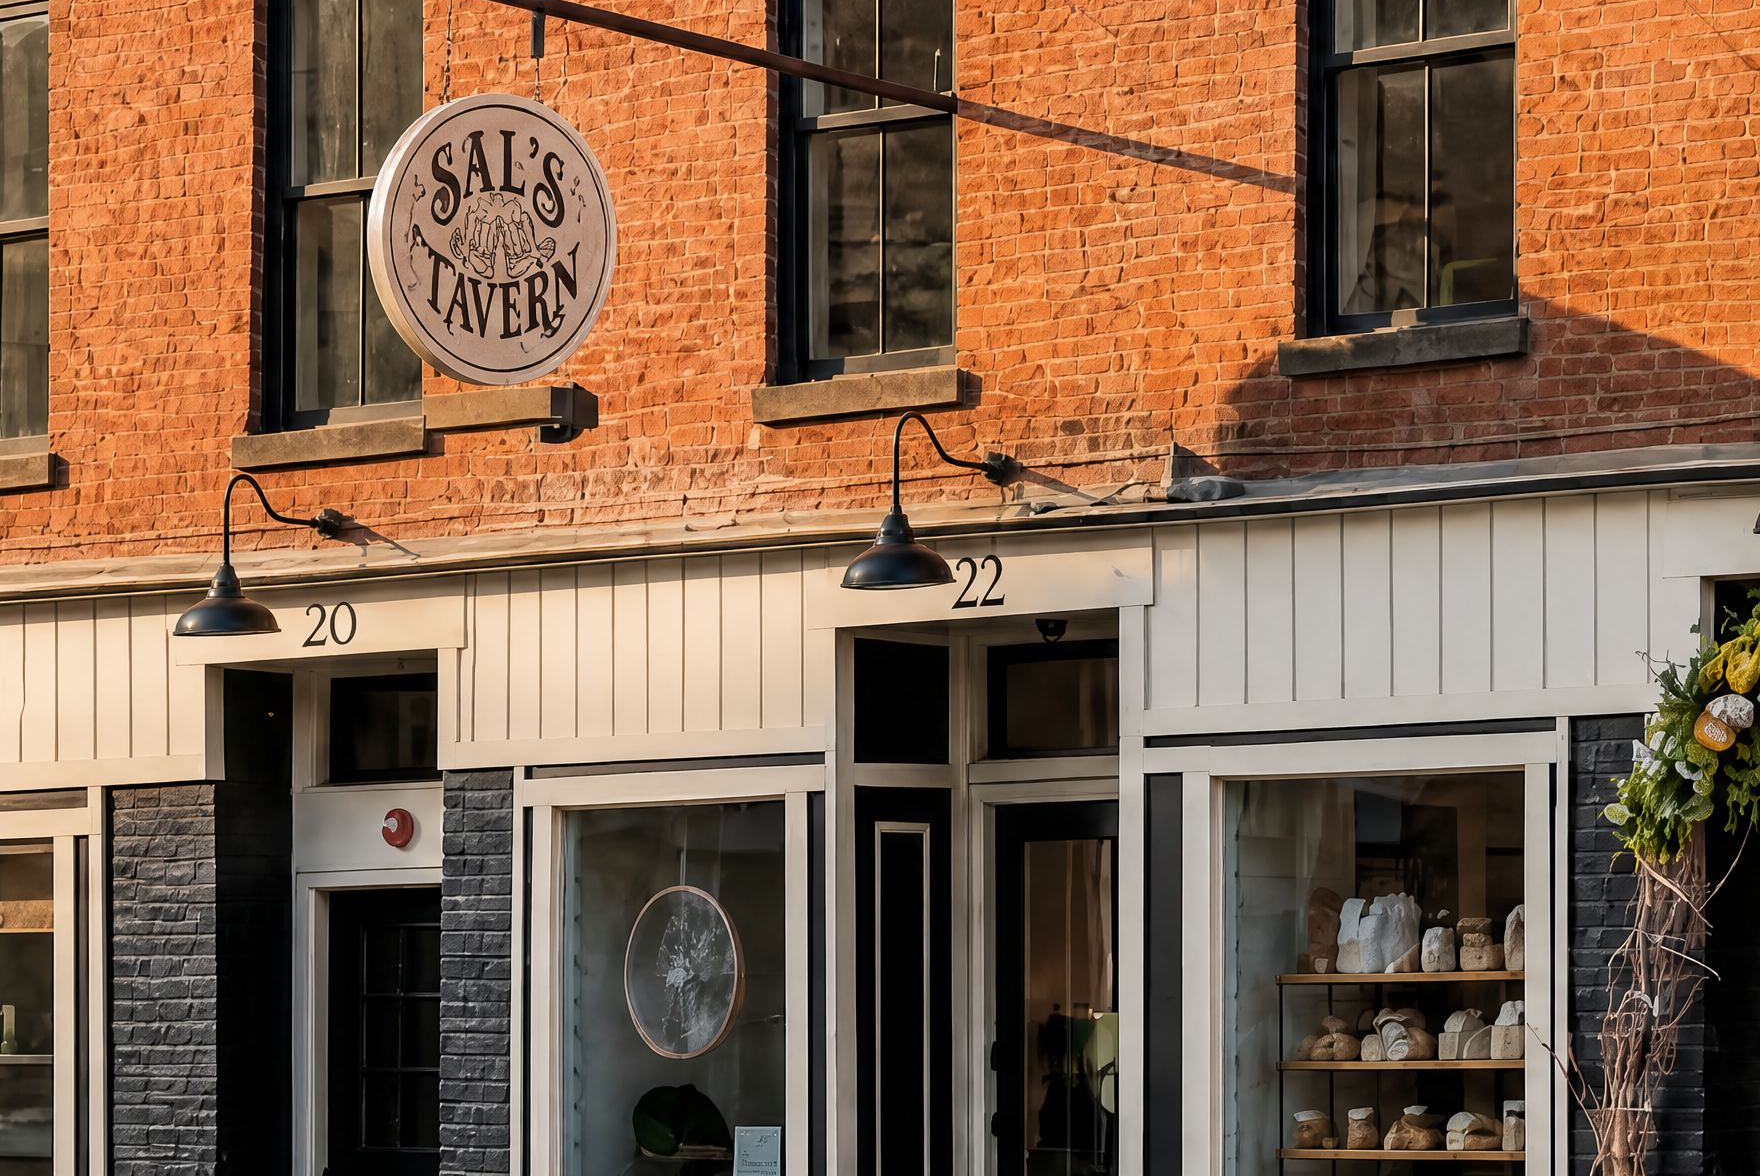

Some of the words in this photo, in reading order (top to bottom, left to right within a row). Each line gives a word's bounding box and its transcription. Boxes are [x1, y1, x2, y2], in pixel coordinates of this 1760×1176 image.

[431, 129, 566, 228] SAL'S
[412, 224, 581, 340] TAVERN
[951, 554, 1006, 610] 22
[302, 601, 357, 647] 20
